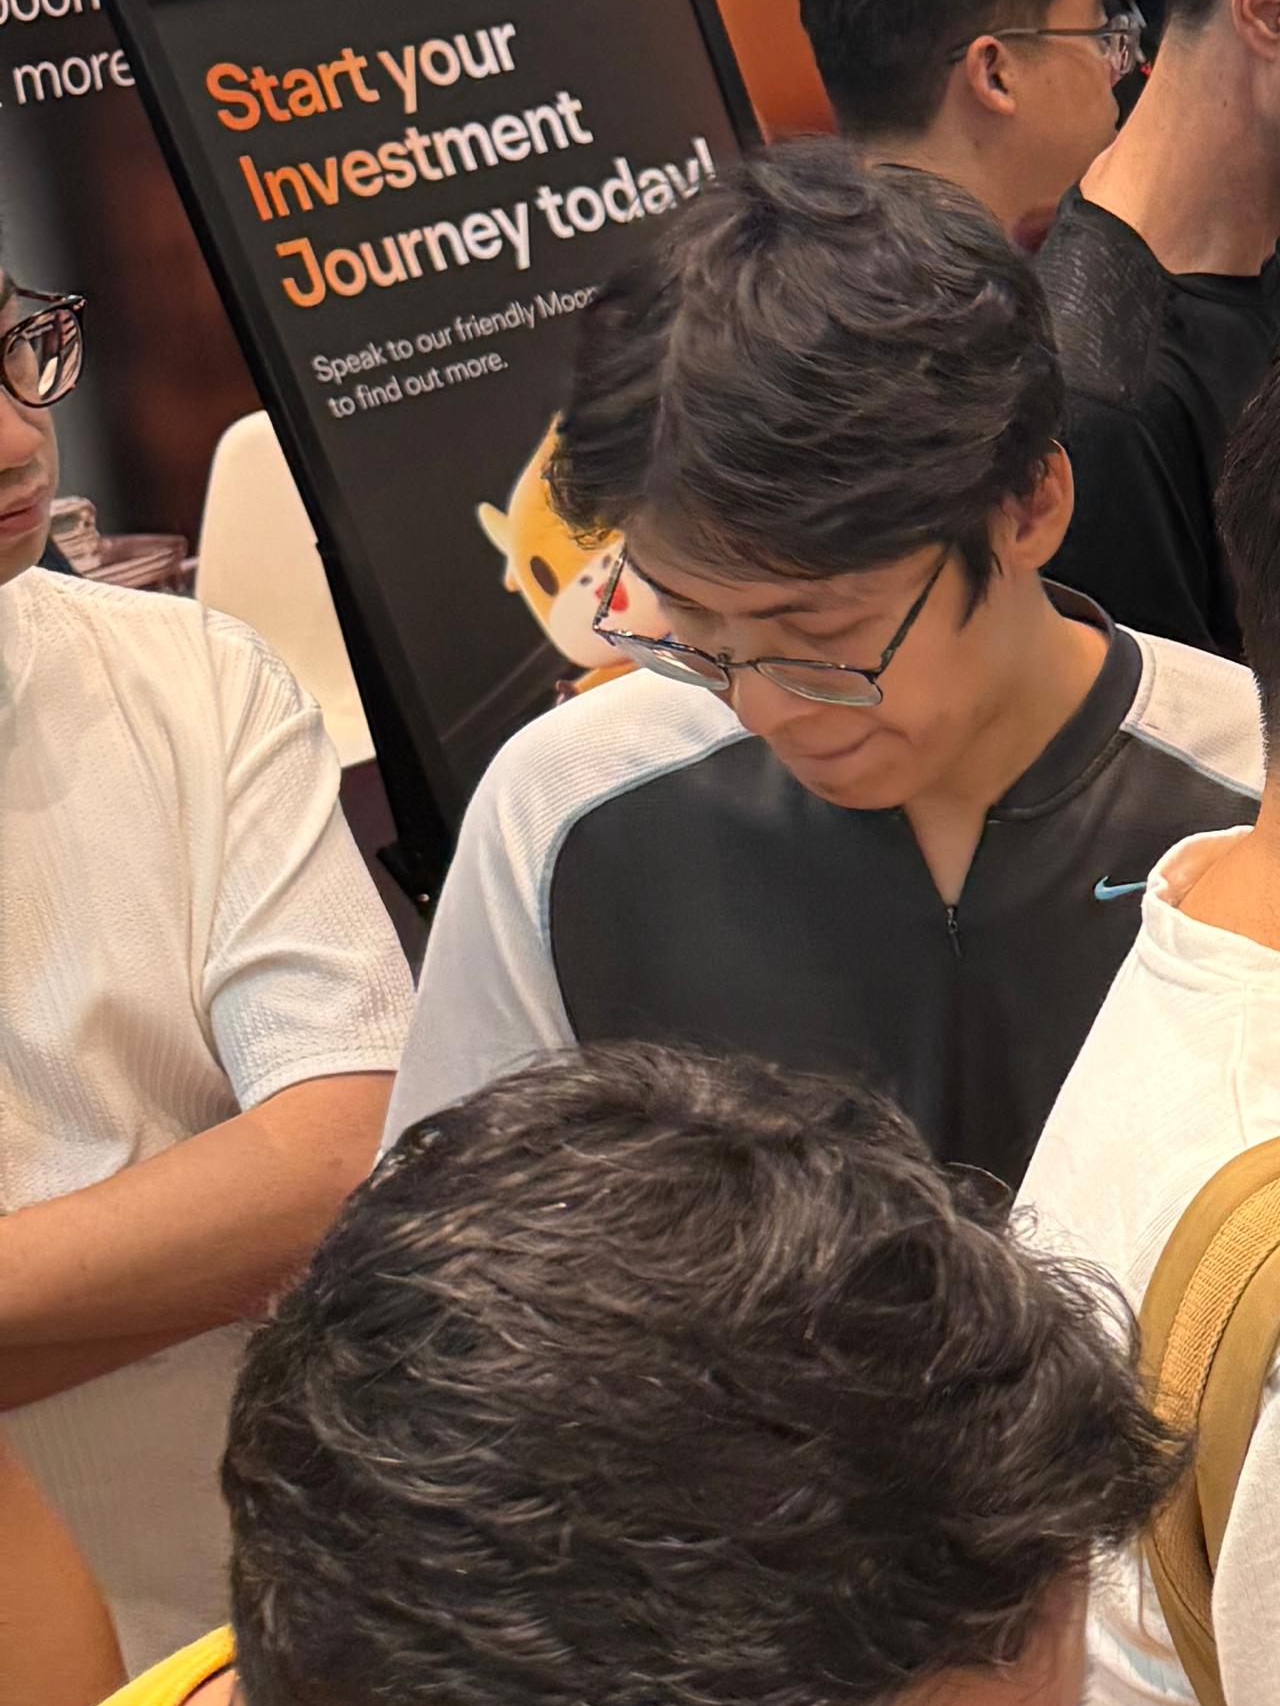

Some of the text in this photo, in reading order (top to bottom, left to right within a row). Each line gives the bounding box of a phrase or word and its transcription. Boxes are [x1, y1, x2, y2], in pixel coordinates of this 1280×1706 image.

[206, 22, 517, 132] Start your
[239, 90, 594, 222] Investment
[275, 137, 719, 309] Journey today!
[312, 342, 388, 386] Speak
[386, 339, 415, 361] to
[416, 326, 453, 354] our
[453, 296, 537, 342] friendly
[327, 351, 510, 419] to find out more.
